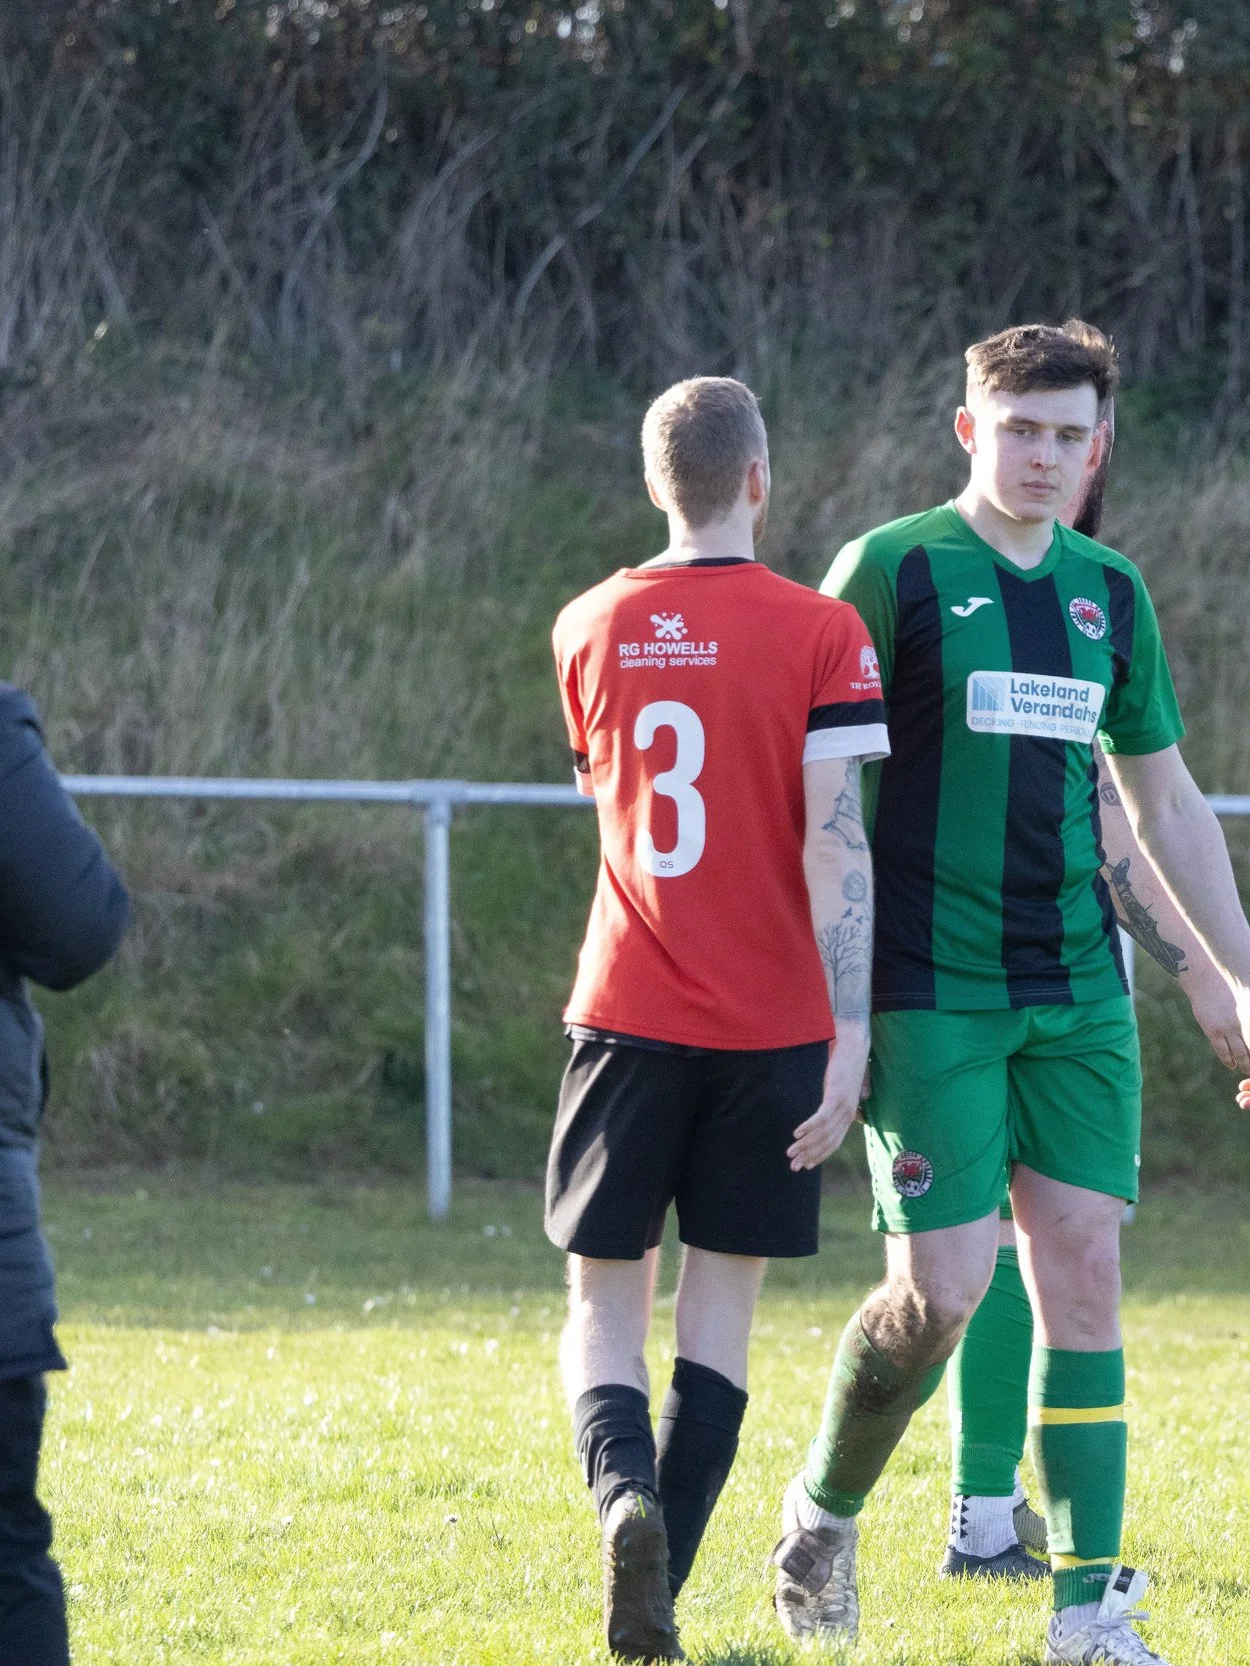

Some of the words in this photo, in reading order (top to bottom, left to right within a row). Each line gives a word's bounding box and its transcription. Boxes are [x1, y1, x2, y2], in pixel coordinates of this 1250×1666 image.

[619, 643, 640, 657] RG
[643, 641, 718, 655] HOWELLS
[620, 656, 666, 669] cleaning
[669, 654, 717, 666] services
[1010, 678, 1090, 703] Lakeland
[1010, 697, 1097, 723] Verandahs
[971, 716, 1015, 728] DECKING
[1020, 719, 1057, 732] FENCING
[633, 700, 706, 877] 3
